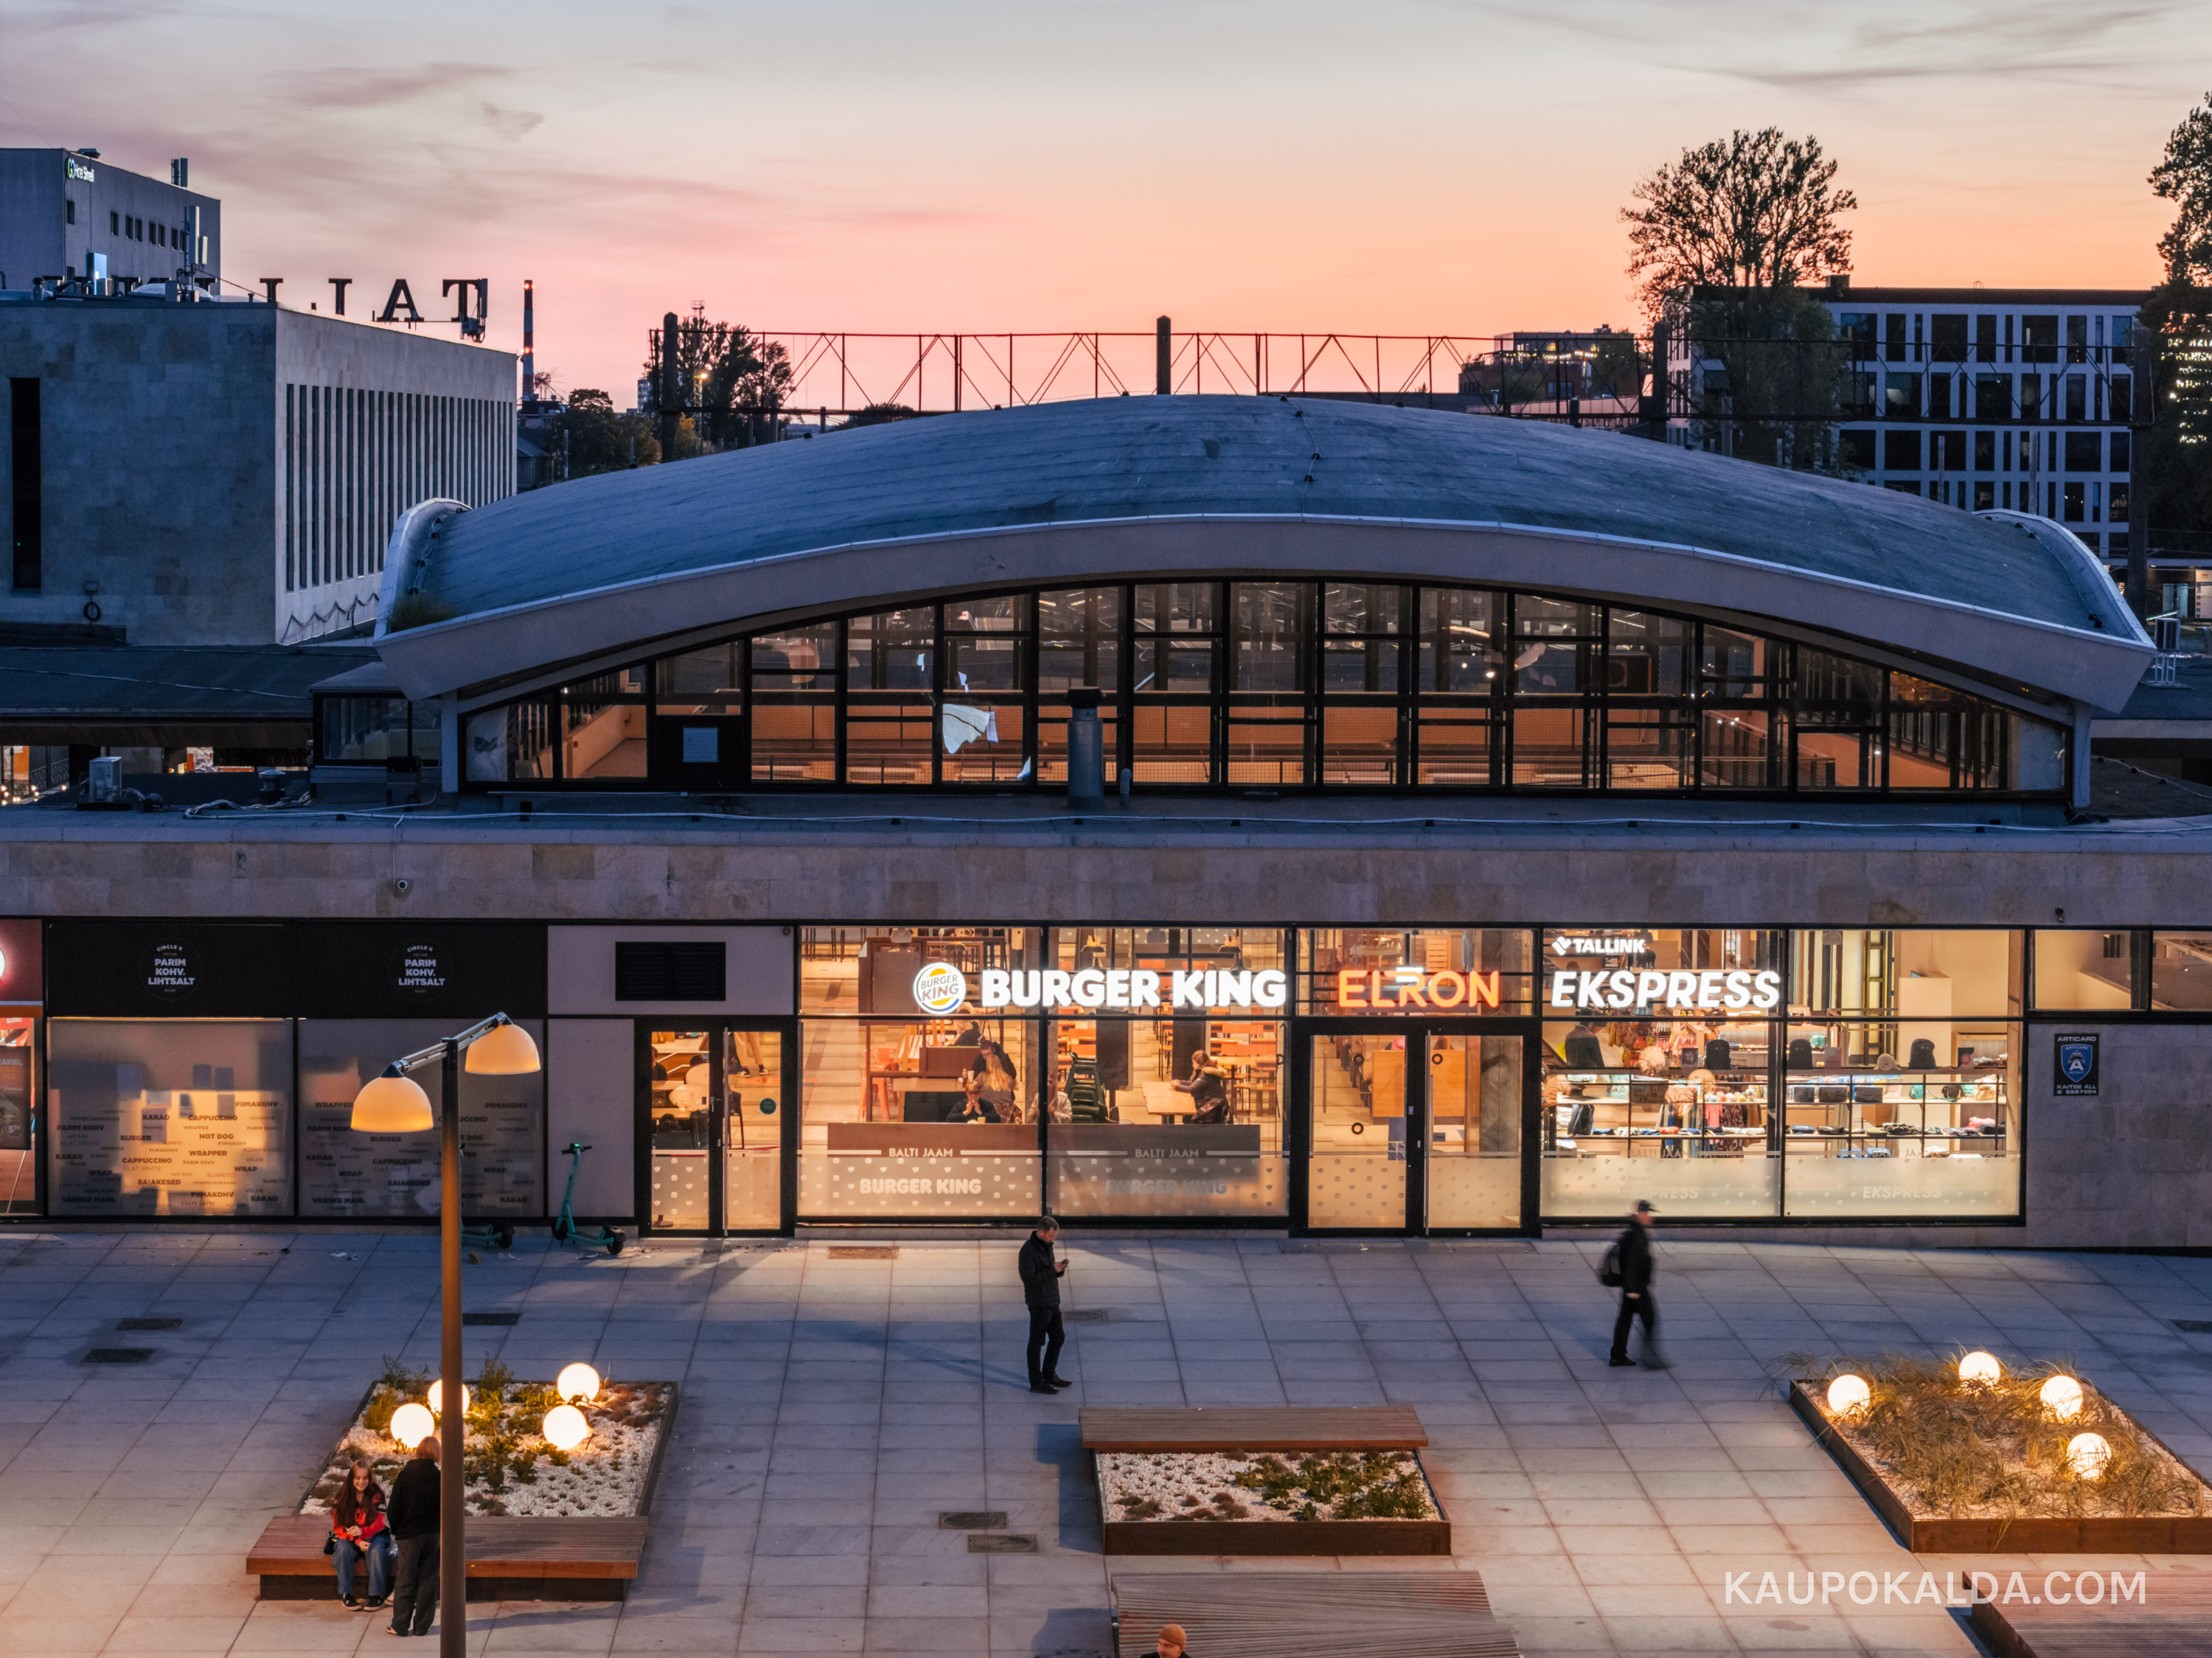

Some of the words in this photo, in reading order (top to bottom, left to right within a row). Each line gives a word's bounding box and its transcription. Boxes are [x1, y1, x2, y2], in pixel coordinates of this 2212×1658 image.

[1573, 938, 1646, 953] TALLINK
[154, 958, 187, 966] PARIM
[405, 959, 437, 967] PARIM
[156, 967, 186, 976] KOHV.
[406, 968, 437, 977] KOHV.
[148, 977, 195, 985] LIHTSALT
[398, 978, 445, 986] LIHTSALT
[921, 974, 959, 990] BURGER
[922, 983, 959, 1002] KING
[981, 969, 1161, 1008] BURGER
[1172, 969, 1287, 1008] KING
[1338, 968, 1500, 1009] ELRON
[1550, 970, 1781, 1009] EKSPRESS
[888, 1148, 919, 1157] BALTI
[922, 1148, 953, 1157] JAAM
[1135, 1149, 1165, 1158] BALTI
[1169, 1149, 1200, 1158] JAAM
[1630, 1149, 1657, 1158] BALTI
[860, 1178, 933, 1194] BURGER
[936, 1178, 982, 1194] KING
[1106, 1179, 1178, 1195] BURGER
[1181, 1179, 1228, 1195] KING
[1619, 1186, 1699, 1199] EKSPRESS
[1863, 1186, 1941, 1199] EKSPRESS
